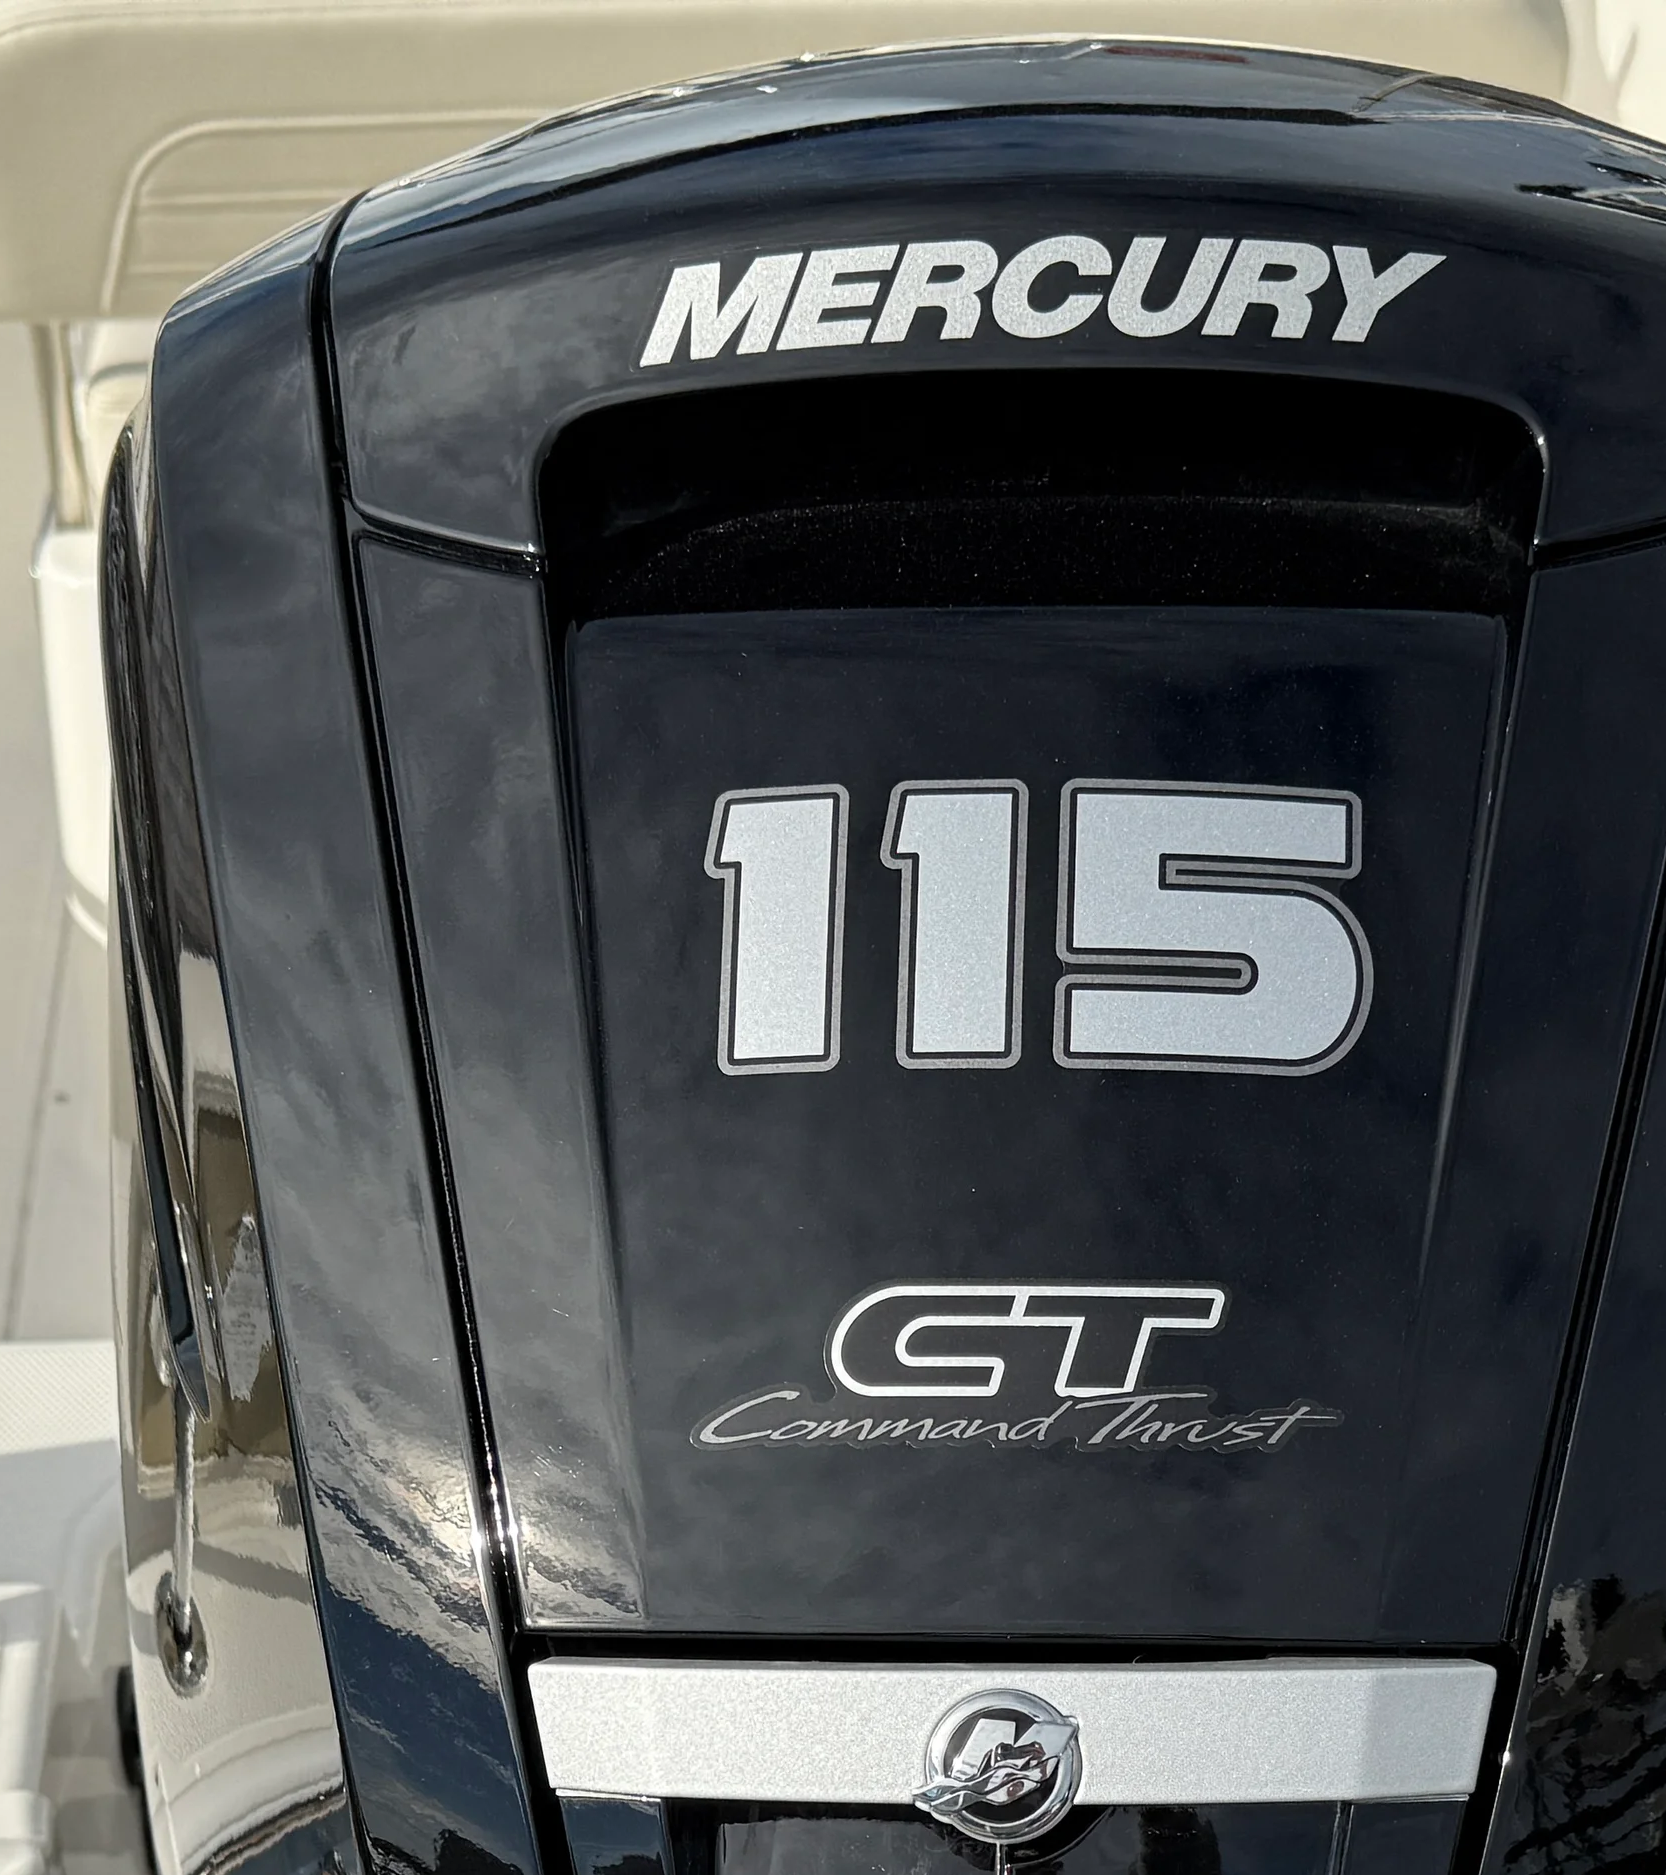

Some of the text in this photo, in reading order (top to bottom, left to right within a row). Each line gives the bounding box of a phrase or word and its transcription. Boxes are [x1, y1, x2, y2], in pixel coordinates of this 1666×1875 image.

[639, 235, 1446, 367] MERCURY
[704, 778, 1373, 1076] 115
[700, 1391, 1338, 1445] Command Thrust
